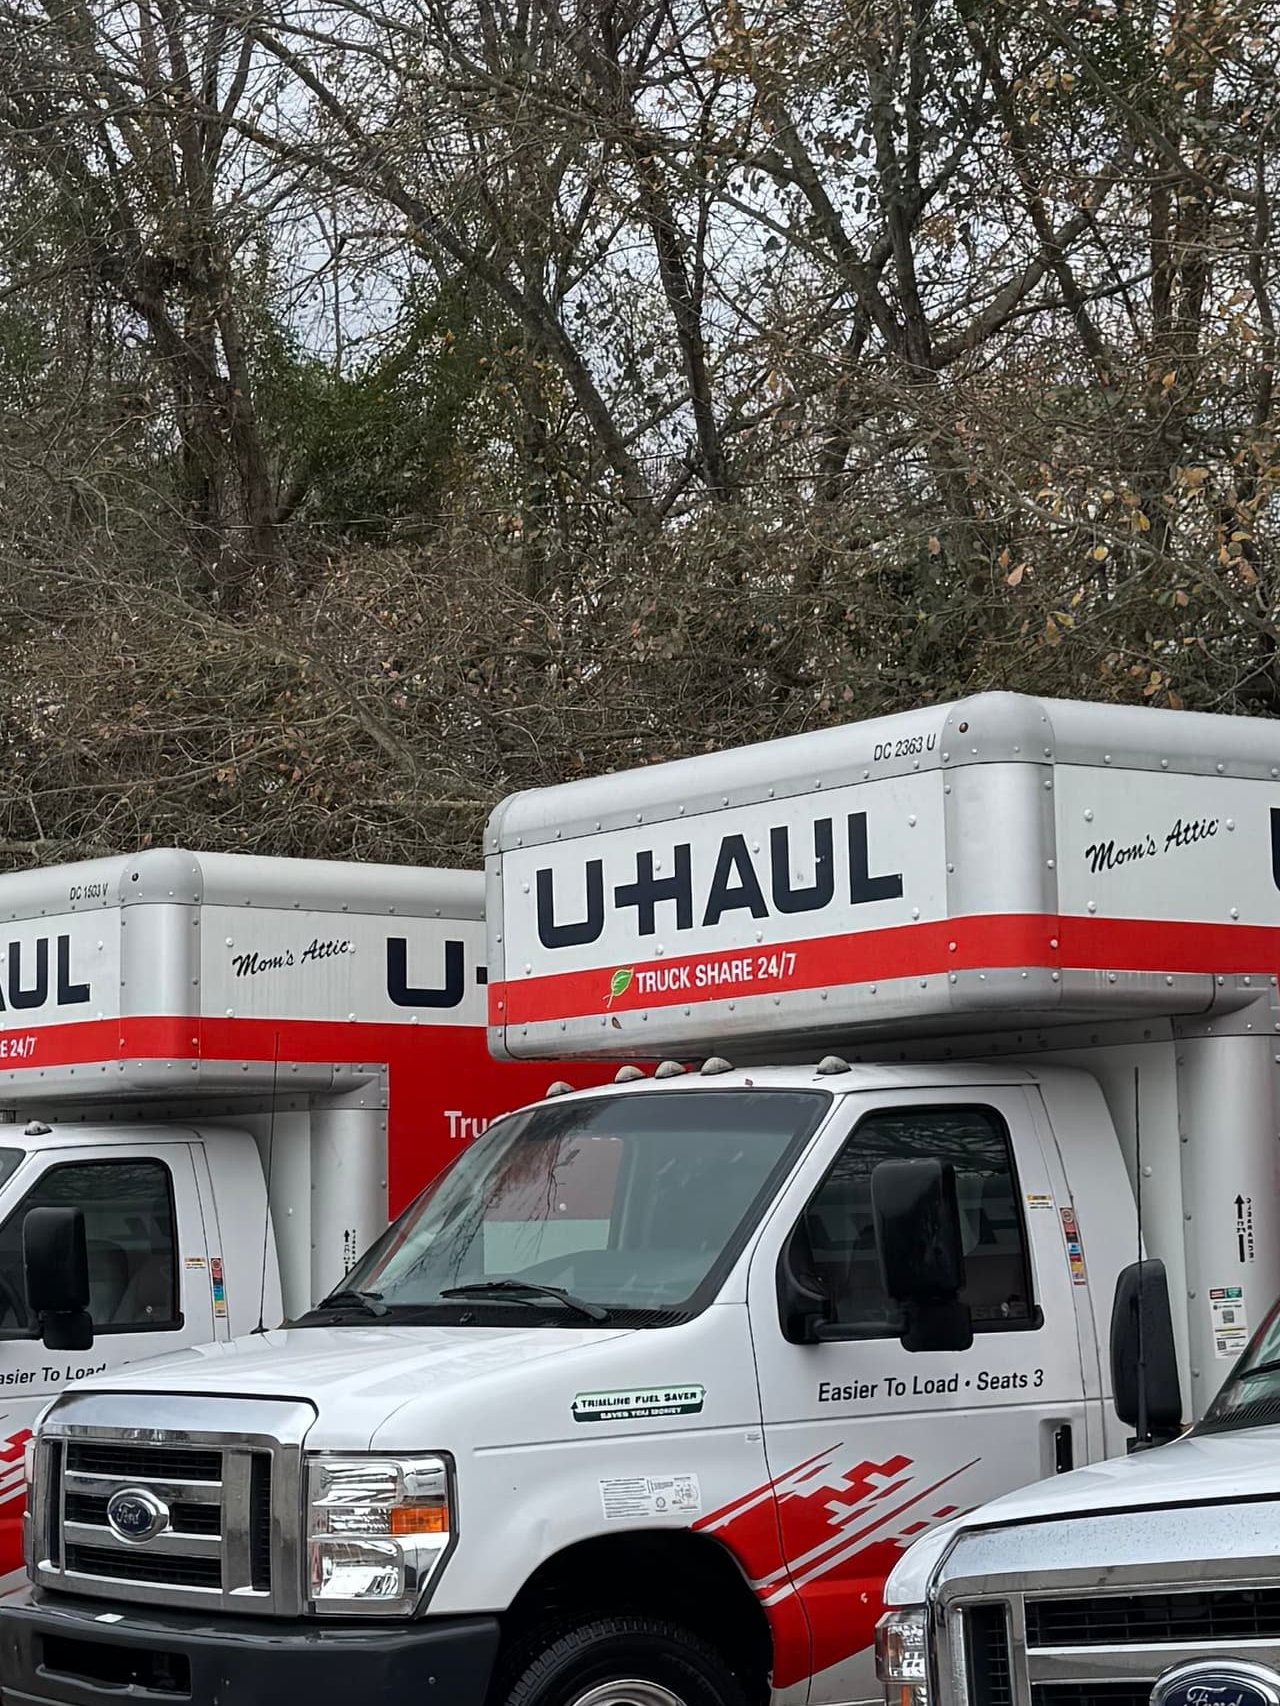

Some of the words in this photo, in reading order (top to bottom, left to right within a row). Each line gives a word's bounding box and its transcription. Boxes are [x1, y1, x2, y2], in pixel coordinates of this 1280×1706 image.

[874, 742, 892, 761] DC
[895, 736, 923, 757] 2363
[927, 733, 936, 751] U
[1085, 834, 1157, 873] Mom's
[1164, 819, 1219, 853] Attic
[232, 949, 294, 977] Mom's
[301, 938, 350, 964] Attic
[636, 966, 690, 993] TRUCK
[696, 959, 753, 987] SHARE
[757, 950, 797, 979] 24/7
[10, 1036, 36, 1059] 24/7
[42, 1367, 60, 1382] To
[818, 1380, 878, 1402] Easier
[884, 1377, 906, 1397] To
[912, 1373, 959, 1395] Load
[976, 1371, 1028, 1391] Seats
[1033, 1369, 1044, 1387] 3
[635, 1395, 661, 1404] FUEL
